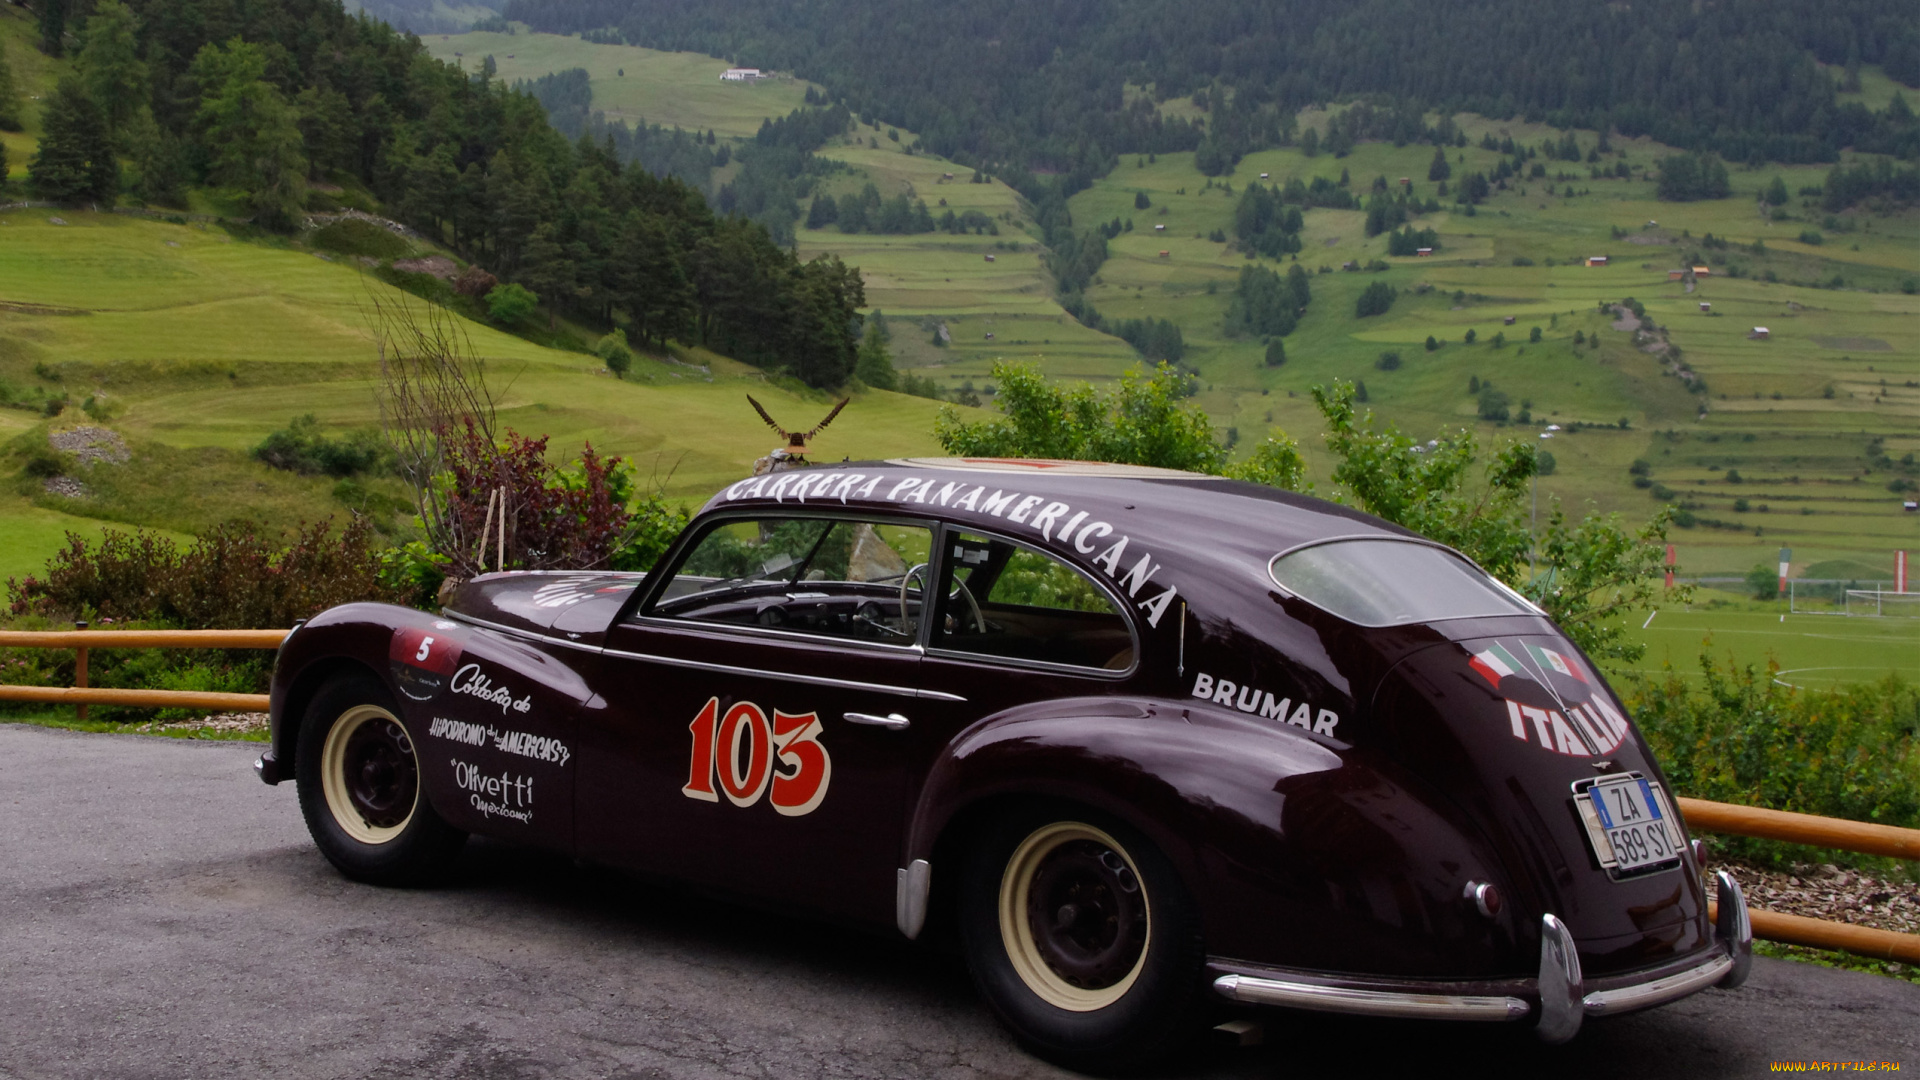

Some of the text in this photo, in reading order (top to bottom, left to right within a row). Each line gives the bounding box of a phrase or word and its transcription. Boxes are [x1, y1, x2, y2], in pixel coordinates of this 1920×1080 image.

[726, 472, 1178, 629] CARRERA PANAMERICANA
[415, 636, 434, 662] 5
[512, 694, 531, 713] de
[1191, 672, 1339, 738] BRUMAR
[1504, 692, 1630, 758] ITALIA
[681, 696, 832, 817] 103
[1610, 786, 1642, 821] ZA
[1610, 822, 1673, 865] 589 SY
